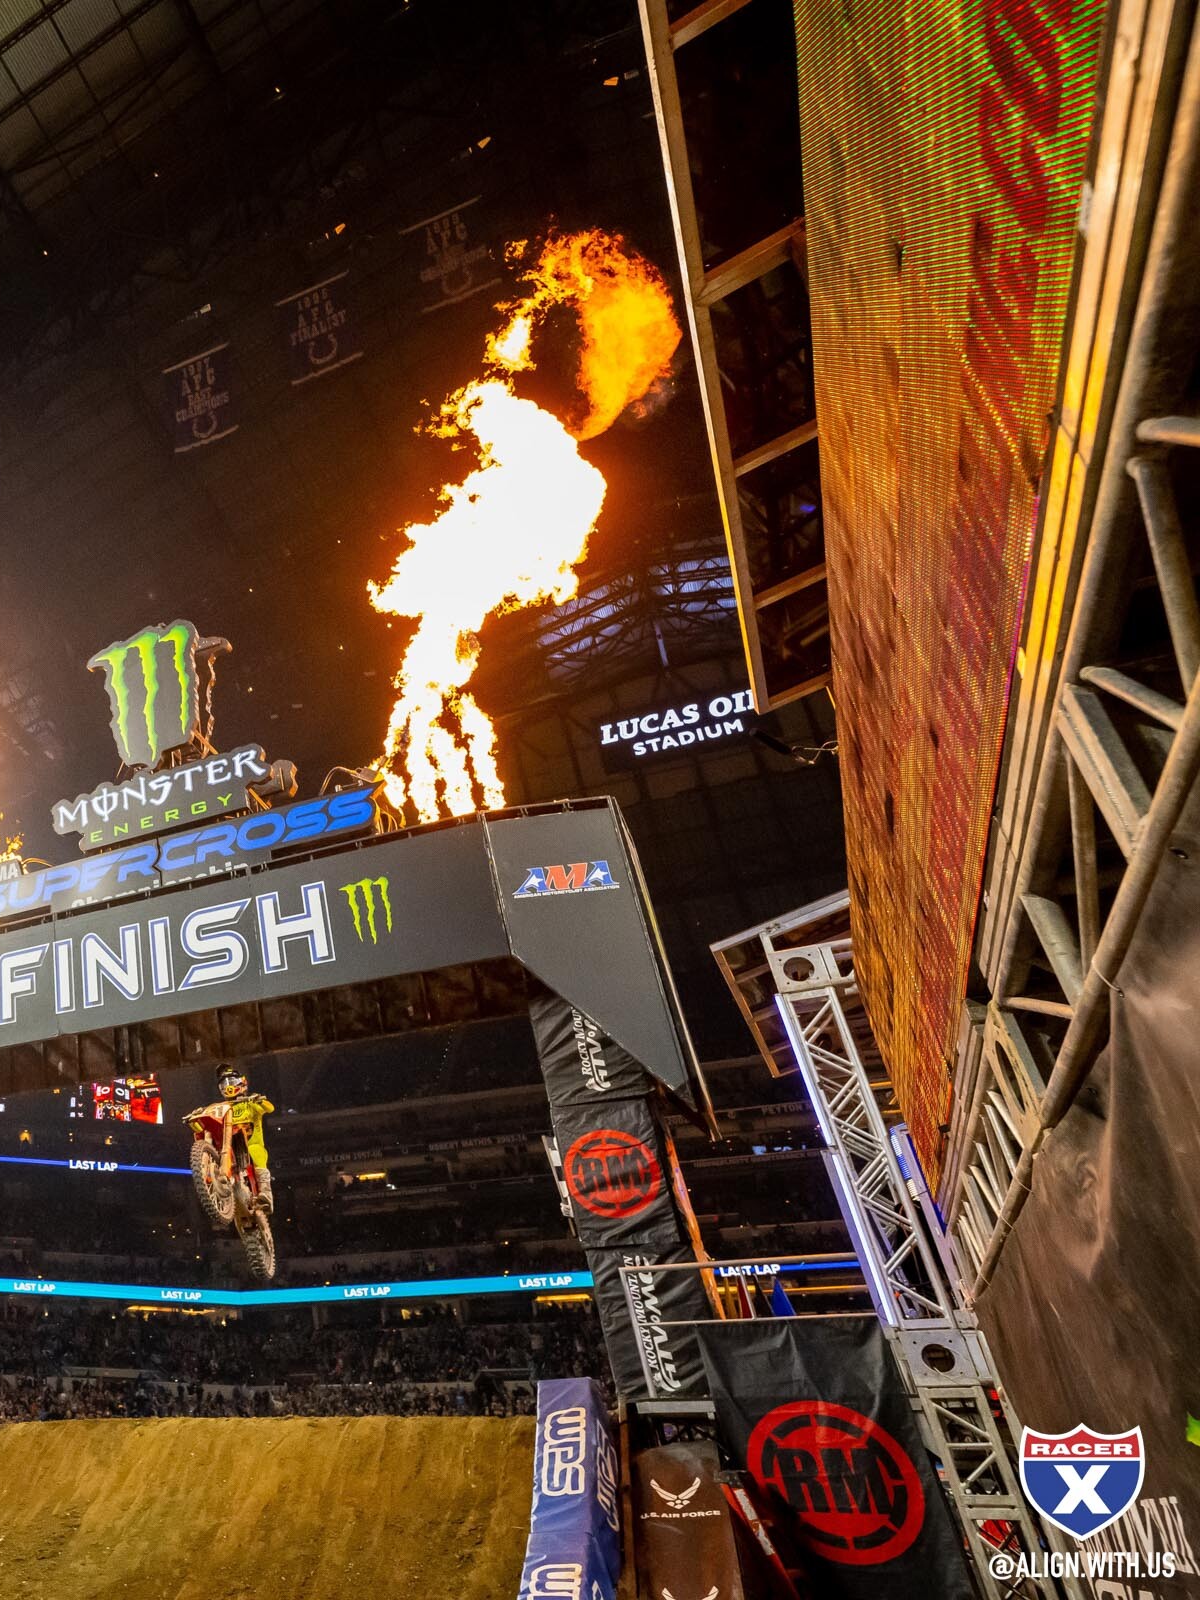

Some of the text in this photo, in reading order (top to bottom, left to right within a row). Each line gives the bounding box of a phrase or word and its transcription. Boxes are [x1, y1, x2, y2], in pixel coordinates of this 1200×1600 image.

[601, 704, 700, 745] LUCAS
[633, 719, 744, 756] STADIUM
[58, 749, 267, 828] MONSTER
[90, 793, 232, 843] ENERGY
[512, 860, 620, 895] AMA
[578, 1041, 592, 1076] ROCKY
[69, 1159, 118, 1171] LAST LAP
[519, 1276, 573, 1288] LAST LAP
[719, 1264, 781, 1277] LAST LAP
[14, 1282, 56, 1292] LAST LAP
[161, 1290, 202, 1300] LAST LAP
[344, 1286, 391, 1298] LAST LAP
[640, 1326, 659, 1371] ROCKY
[682, 1510, 721, 1518] FORCE
